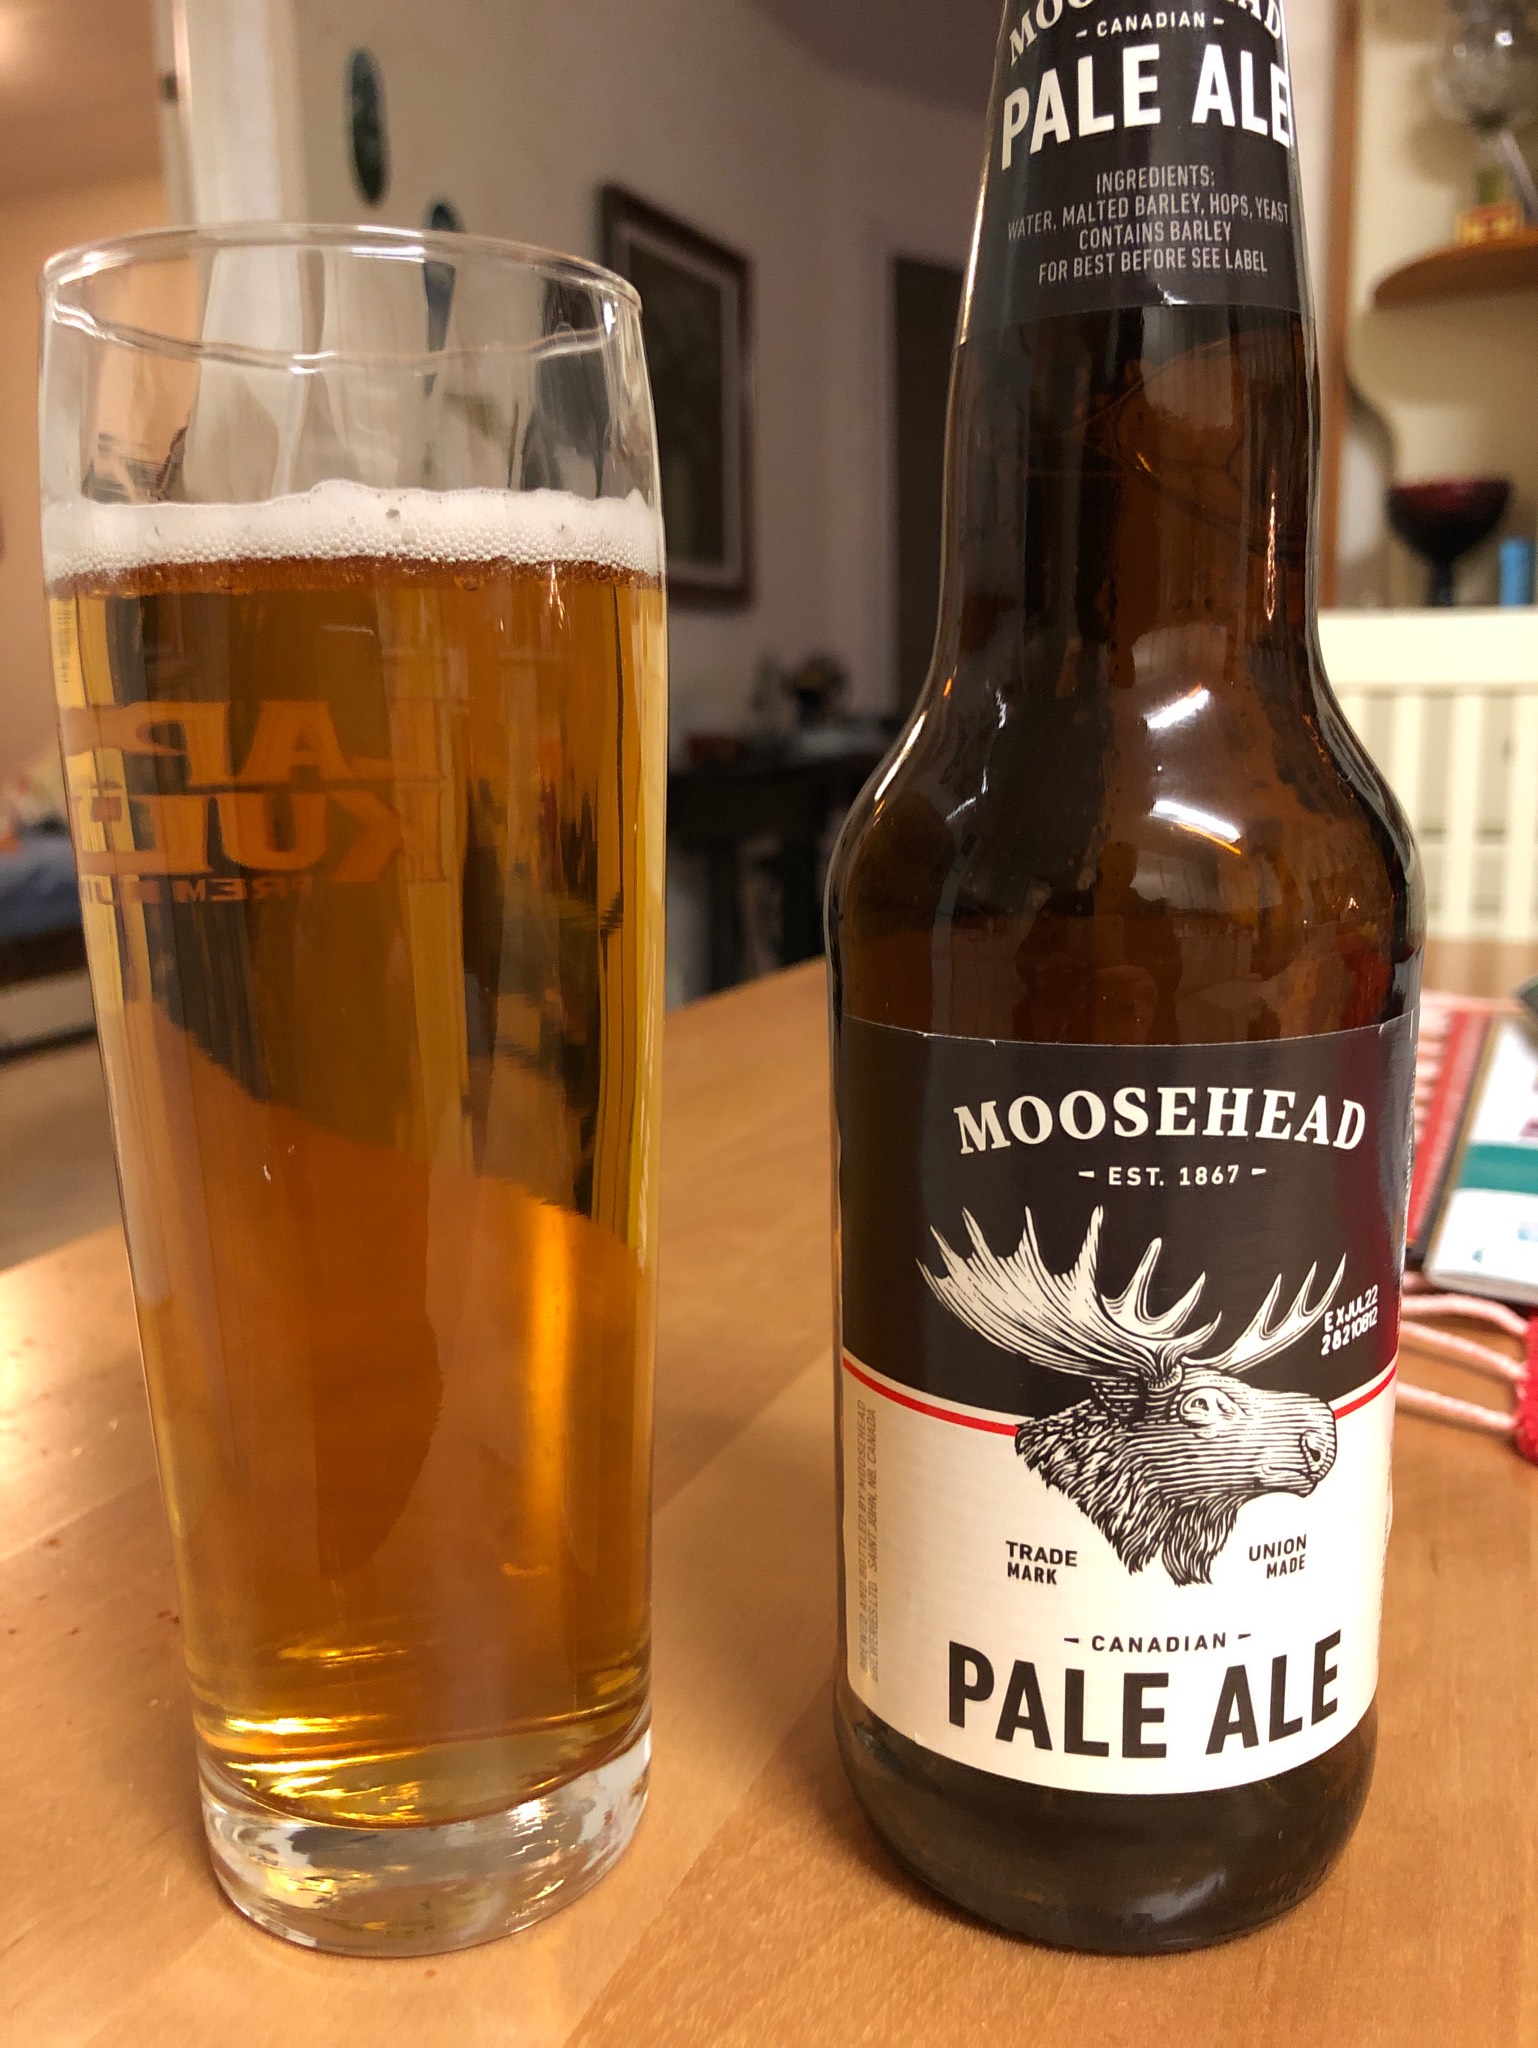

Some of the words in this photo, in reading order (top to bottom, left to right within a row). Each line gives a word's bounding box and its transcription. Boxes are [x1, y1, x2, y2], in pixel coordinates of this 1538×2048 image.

[1097, 11, 1206, 37] CANADIAN
[1001, 44, 1161, 171] PALE
[1192, 44, 1292, 149] ALE
[1096, 164, 1215, 194] INGREDIENTS:
[1062, 195, 1129, 227] MALTED
[1135, 192, 1205, 217] BARLEY,
[1209, 193, 1253, 220] HOPS,
[1255, 196, 1289, 224] YEAST
[1079, 220, 1164, 250] CONTAINS
[1170, 220, 1232, 242] BARLEY
[1038, 260, 1068, 285] FOR
[1073, 252, 1115, 278] BEST
[1121, 248, 1187, 273] BEFORE
[1192, 247, 1221, 269] SEE
[1225, 248, 1268, 273] LABEL
[953, 1086, 1367, 1155] MOOSEHEAD
[1108, 1166, 1165, 1186] EST.
[1178, 1165, 1240, 1186] 1867
[857, 1399, 867, 1490] MOOSEHEAD
[866, 1408, 877, 1465] CANADA
[858, 1490, 867, 1513] BY
[858, 1513, 867, 1579] BOTTLED
[867, 1530, 878, 1573] SAINT
[1005, 1540, 1078, 1568] TRADE
[1248, 1534, 1308, 1562] UNION
[1006, 1562, 1058, 1585] MARK
[1266, 1553, 1306, 1580] MADE
[858, 1580, 868, 1612] AND
[858, 1612, 868, 1672] BREWED
[1091, 1631, 1227, 1653] CANADIAN
[948, 1640, 1170, 1759] PALE
[1204, 1629, 1342, 1755] ALE
